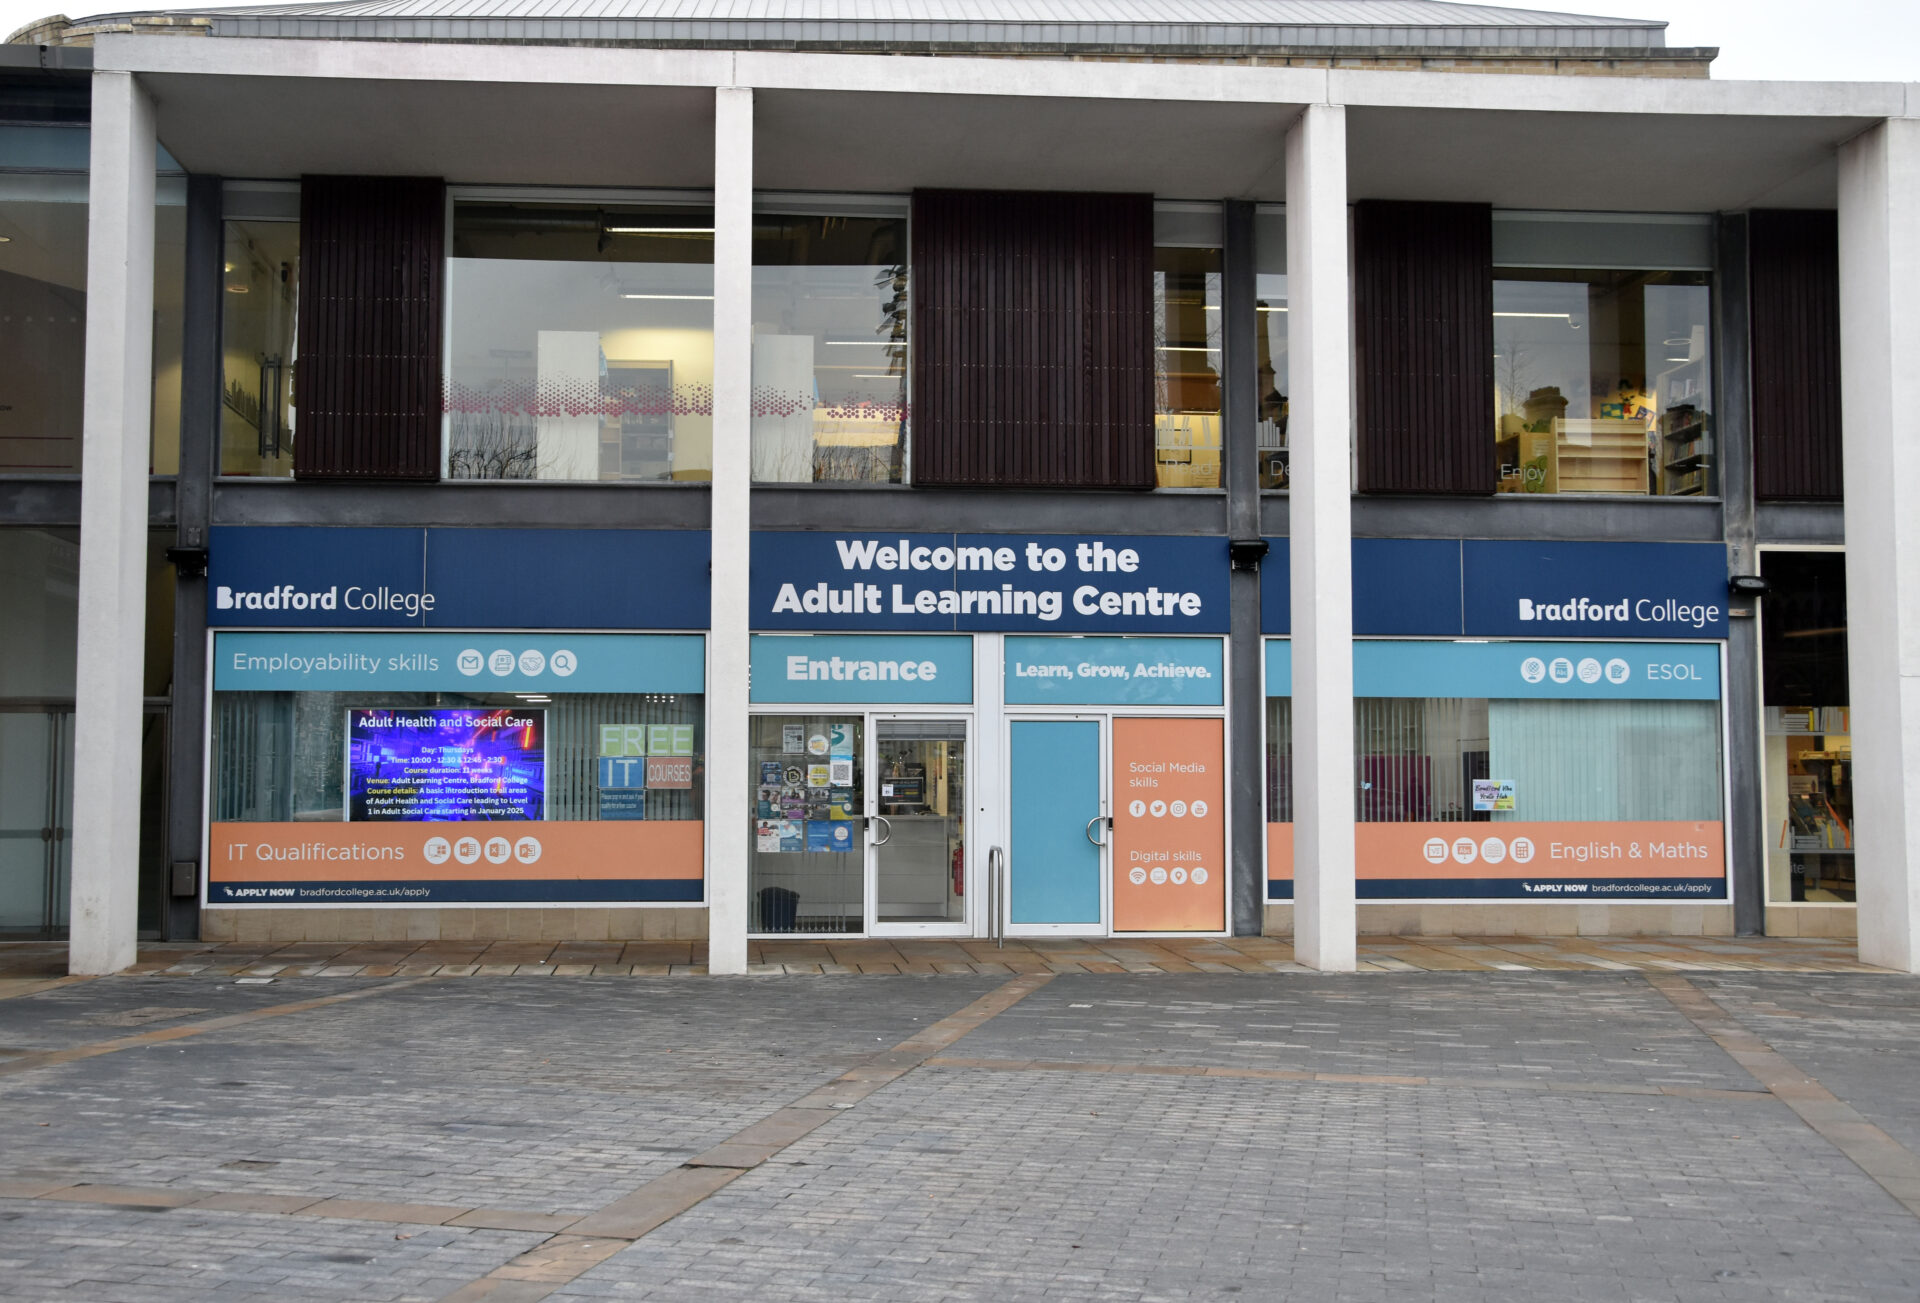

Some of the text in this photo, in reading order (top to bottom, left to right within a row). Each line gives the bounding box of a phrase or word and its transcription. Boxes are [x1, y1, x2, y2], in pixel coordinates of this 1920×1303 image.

[1501, 463, 1547, 484] Enjoy
[835, 539, 1140, 573] Welcome to the
[216, 585, 435, 617] Bradford College
[771, 582, 1202, 621] Adult Learning Centre
[1518, 597, 1720, 628] Bradford College
[233, 653, 439, 674] Employability skills
[786, 655, 938, 681] Entrance
[1016, 662, 1212, 680] Learn, Grow, Achieve.
[1647, 664, 1702, 680] ESOL
[359, 716, 534, 728] Adult Health and Social Care
[602, 726, 692, 755] FREE
[421, 747, 437, 755] Day:
[608, 760, 638, 787] IT
[648, 765, 691, 783] COURSES
[1129, 762, 1206, 773] Social Media
[412, 777, 442, 786] Learning
[443, 777, 469, 785] Centre,
[1129, 777, 1159, 788] skills
[474, 797, 499, 806] leading
[381, 807, 400, 815] Adult
[401, 807, 423, 815] Social
[424, 807, 440, 815] Care
[441, 807, 469, 816] starting
[469, 807, 476, 815] in
[477, 807, 506, 816] January
[228, 842, 405, 861] IT Qualifications
[1130, 850, 1202, 863] Digital skills
[1550, 842, 1708, 862] English & Maths
[235, 887, 430, 898] APPLY NOW bradfordcollege.ac.uk/apply
[1533, 884, 1712, 893] APPLY NOW bradfordcollege.ac.uk/apply
